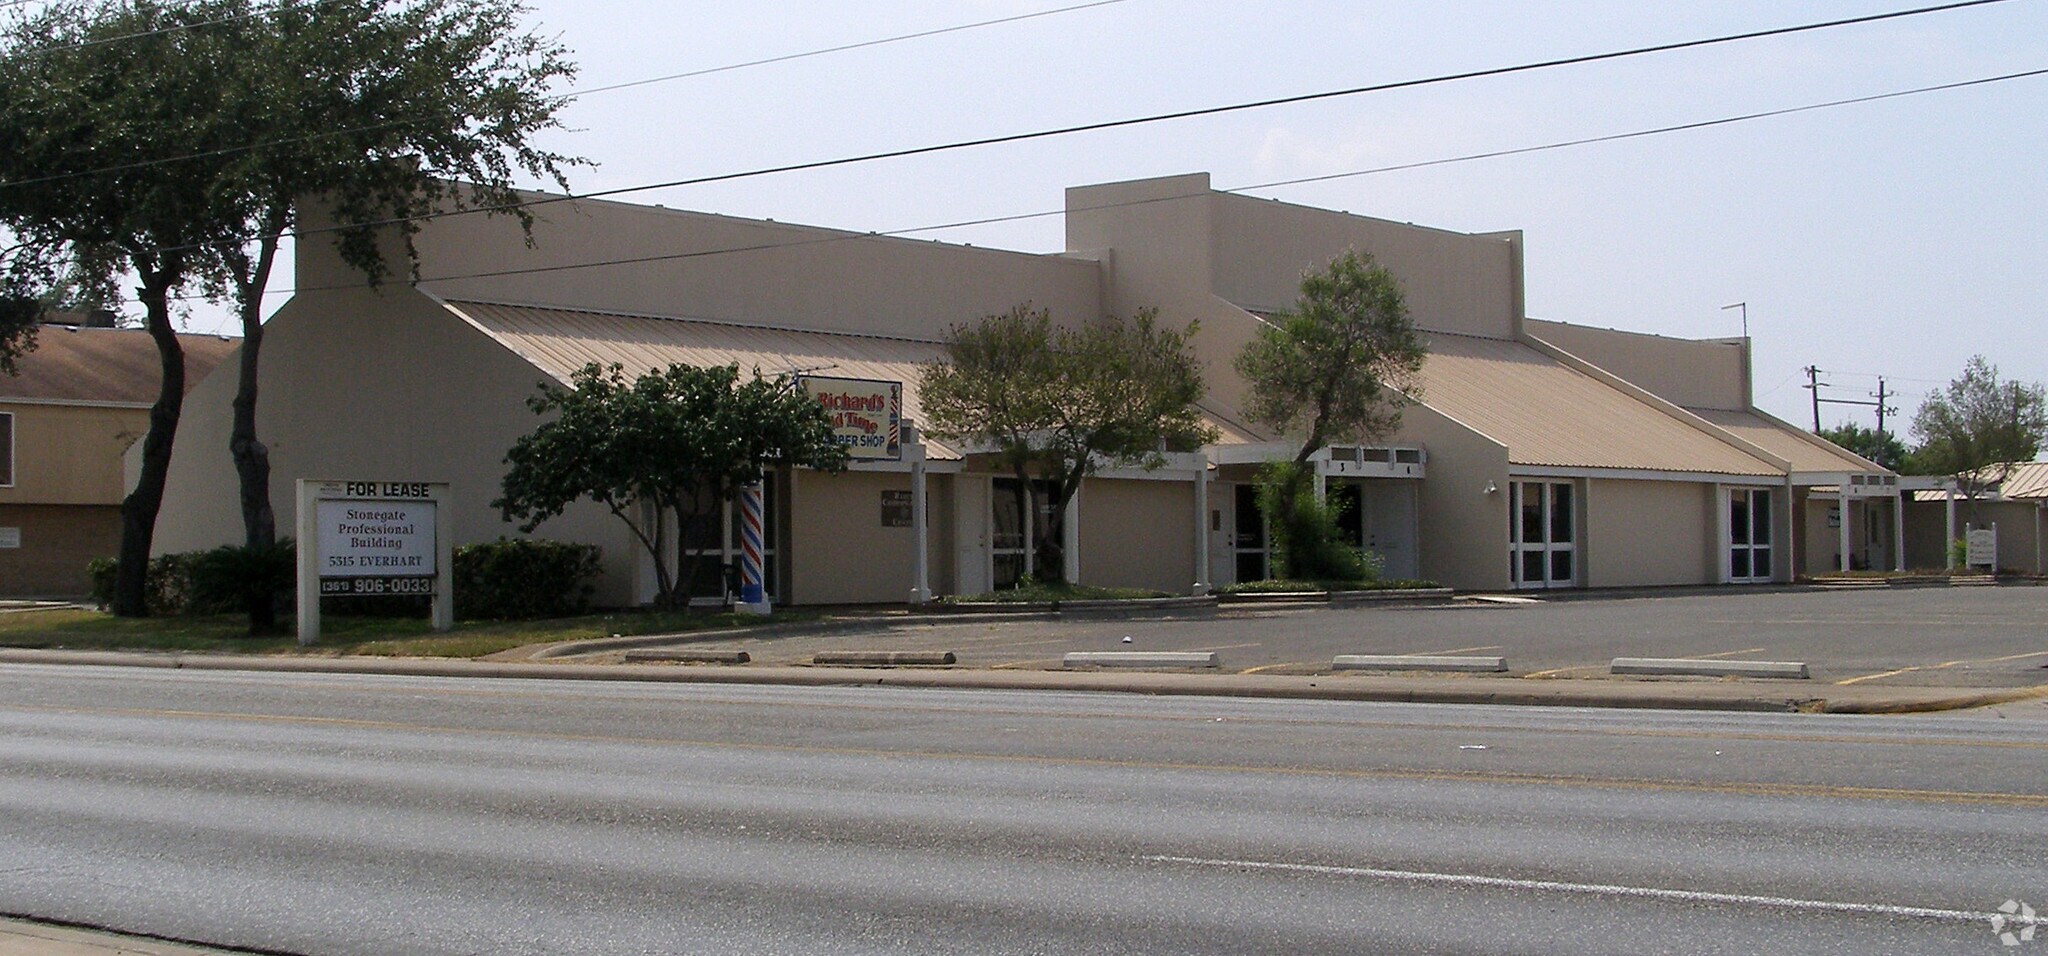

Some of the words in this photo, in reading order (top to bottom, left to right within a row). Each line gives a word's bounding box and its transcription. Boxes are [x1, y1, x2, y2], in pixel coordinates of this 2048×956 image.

[816, 392, 885, 412] Richard's
[845, 412, 878, 434] Time
[860, 435, 885, 447] SHOP
[346, 482, 377, 497] FOR
[383, 482, 430, 498] LEASE
[346, 509, 406, 523] Stonegate
[338, 524, 415, 535] Professional
[351, 537, 402, 550] Building
[359, 556, 423, 567] EVERHART
[322, 581, 350, 592] (361)
[354, 578, 430, 593] 906-0033
